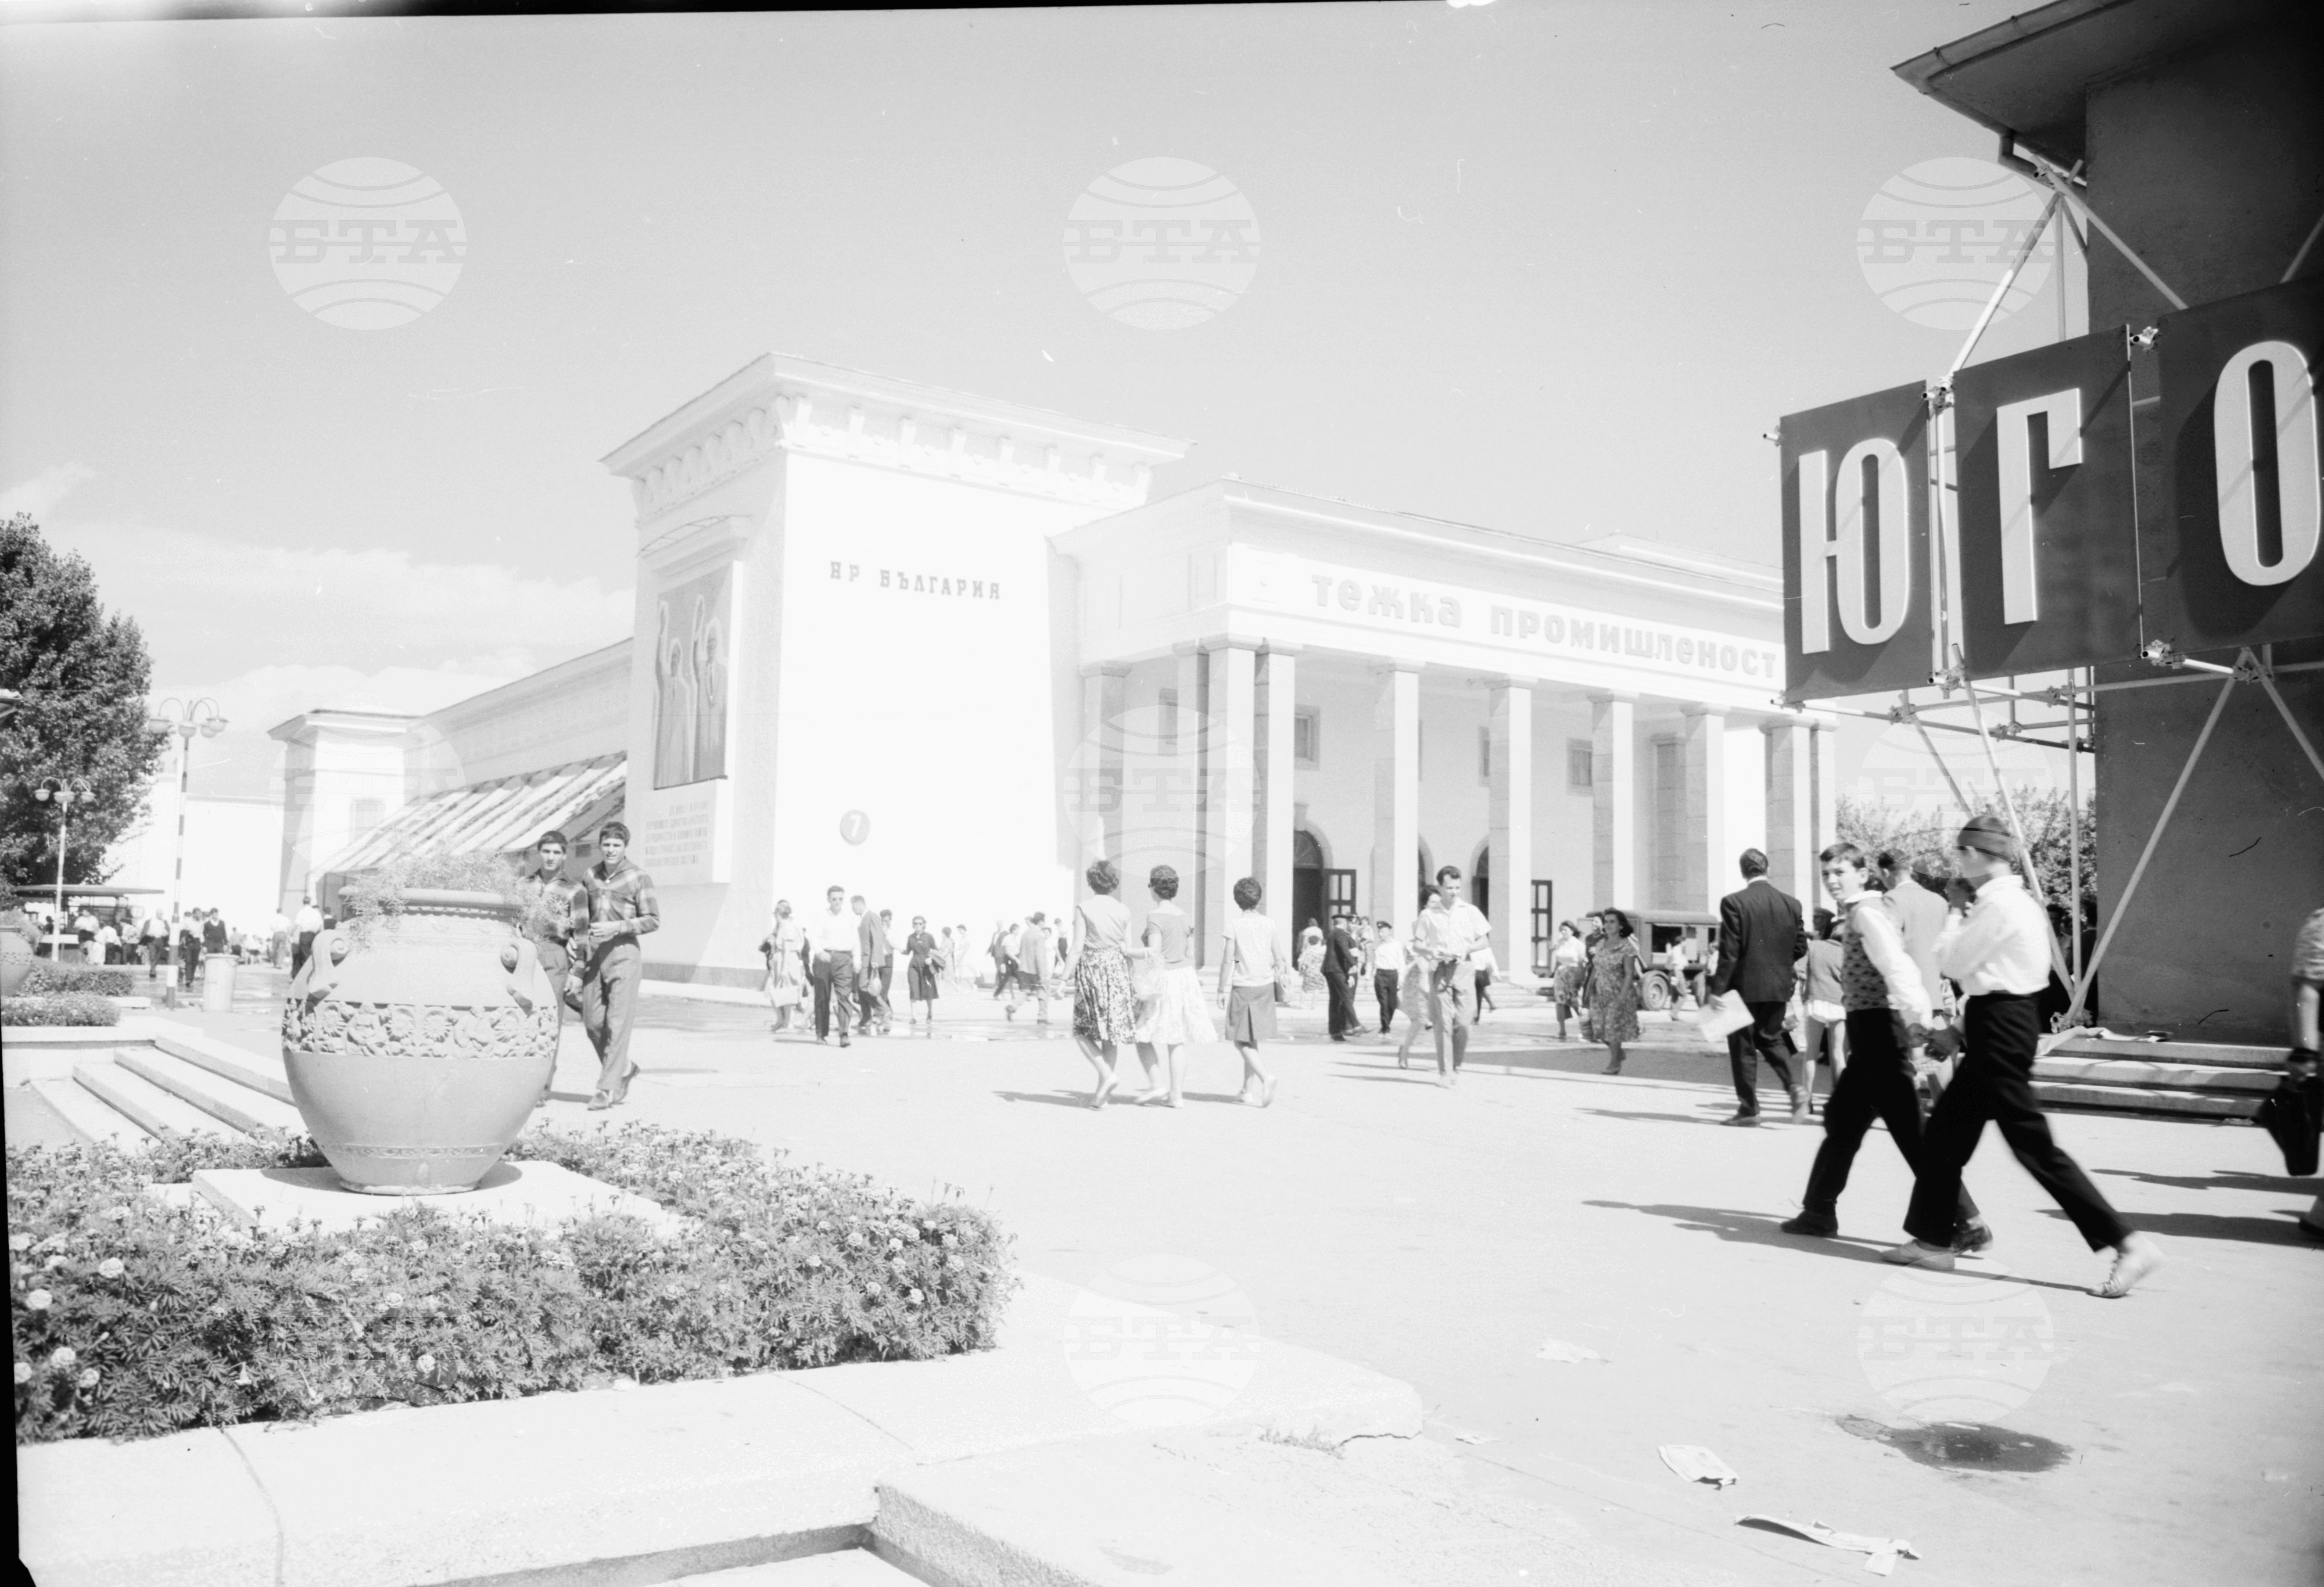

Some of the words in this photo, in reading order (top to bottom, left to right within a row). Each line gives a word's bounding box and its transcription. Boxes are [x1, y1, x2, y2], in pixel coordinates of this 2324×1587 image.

[1798, 340, 2323, 655] ЮГО
[830, 561, 860, 582] НР
[880, 569, 1000, 600] БЪЛГАРИЯ
[1311, 574, 1463, 628] тежка
[1491, 605, 1777, 677] промишленост
[849, 814, 862, 837] 7
